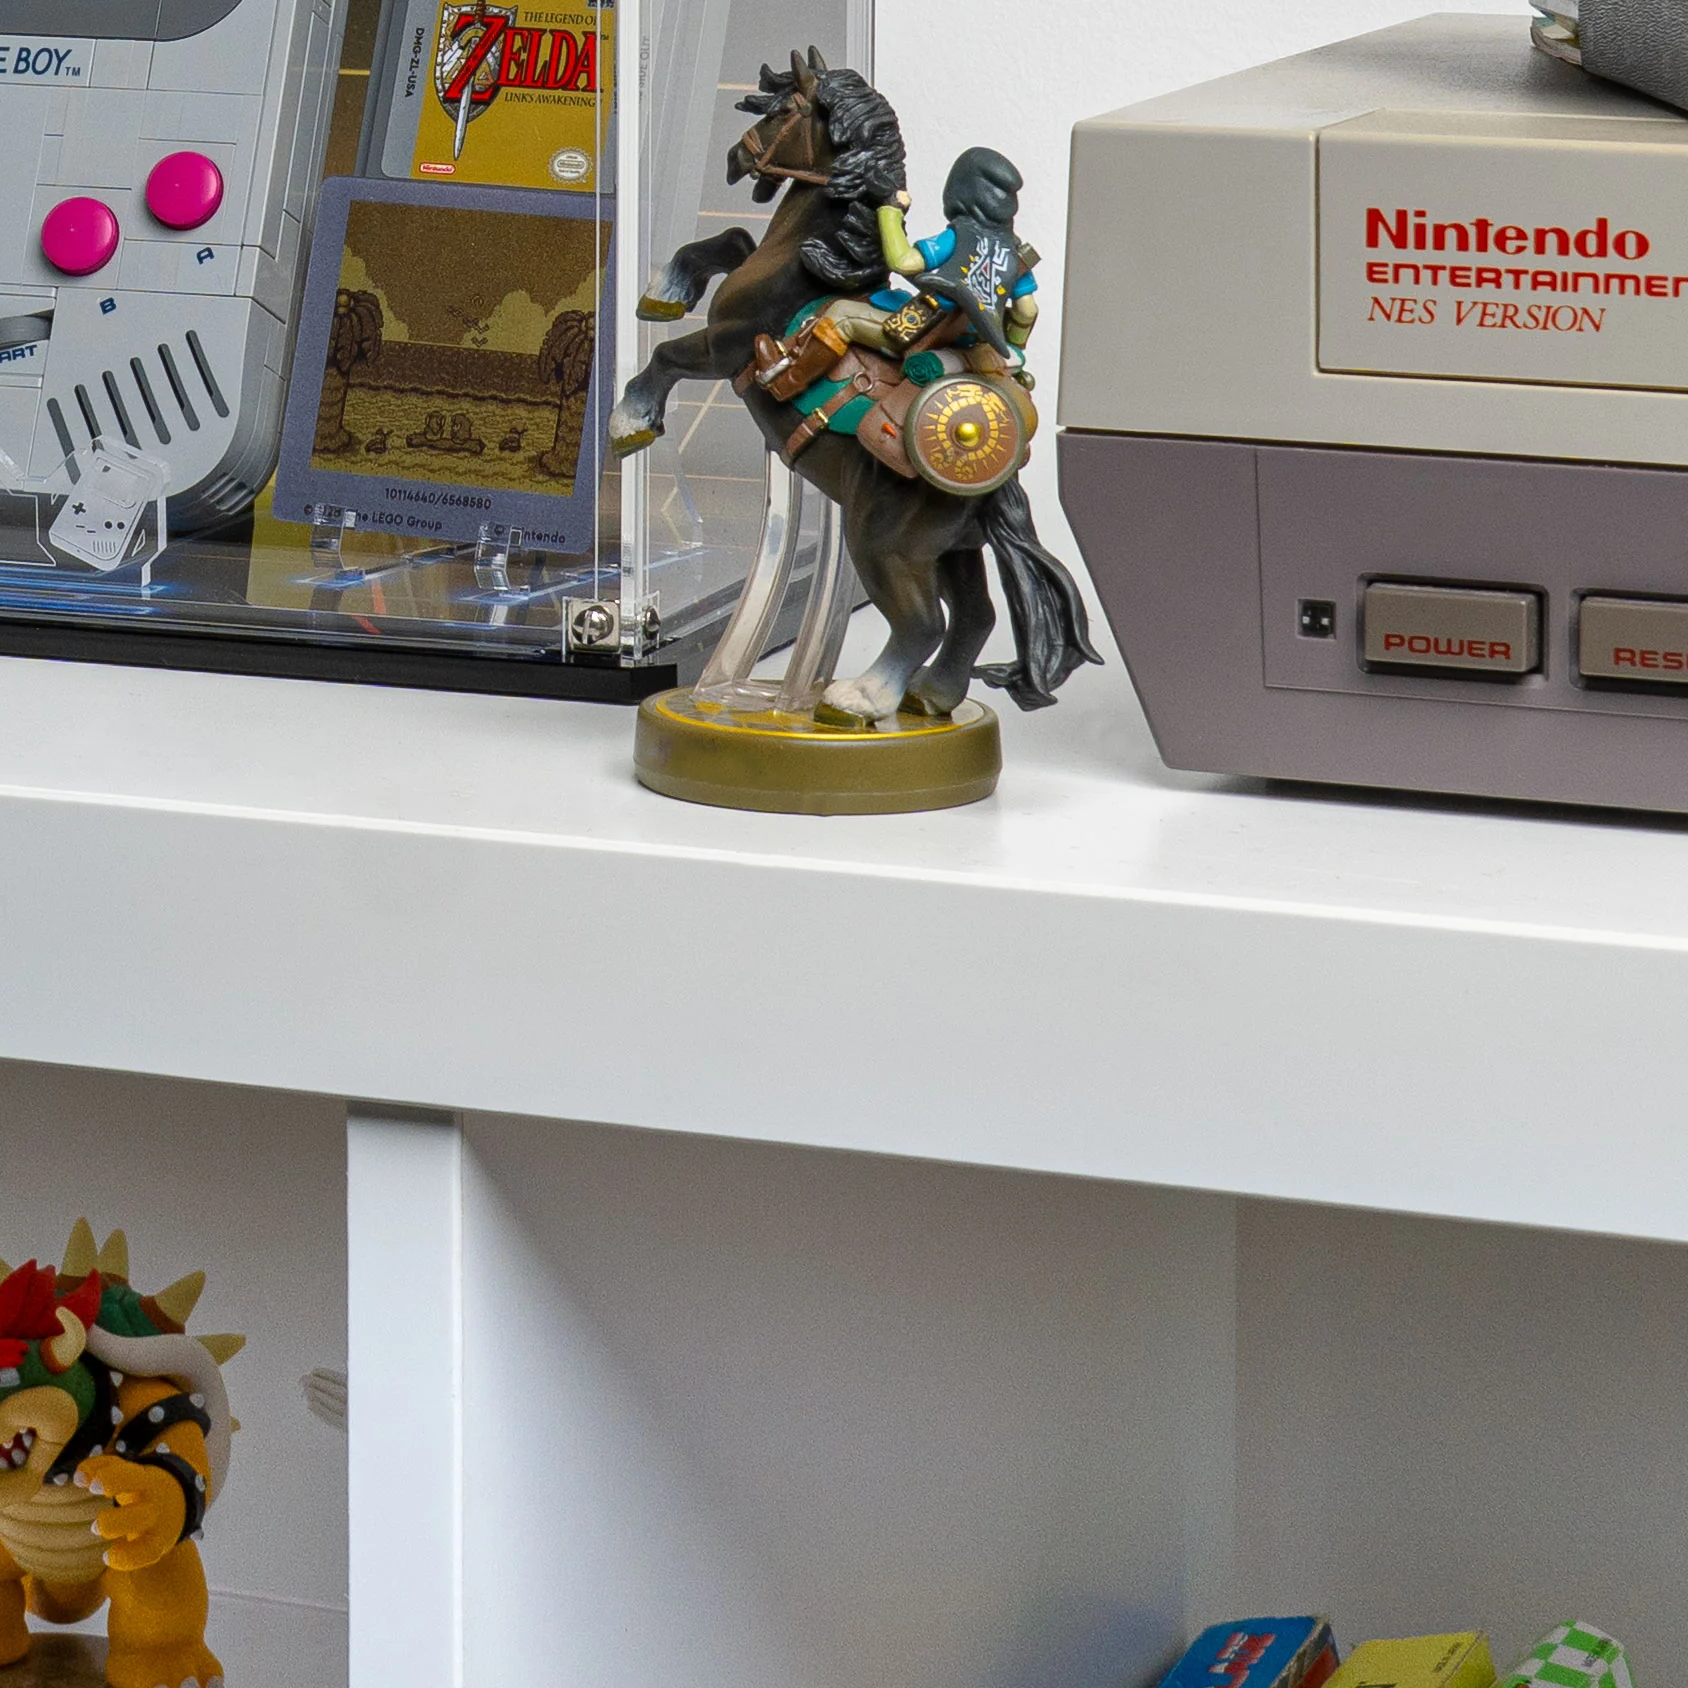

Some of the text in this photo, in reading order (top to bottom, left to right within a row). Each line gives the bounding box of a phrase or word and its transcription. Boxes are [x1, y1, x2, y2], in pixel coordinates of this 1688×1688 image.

[524, 11, 544, 23] THE
[544, 12, 584, 25] LEGEND
[405, 27, 425, 98] DMG-ZL-USA
[444, 13, 603, 104] ZELDA
[535, 93, 596, 108] AWAKENING
[1366, 207, 1650, 261] Nintendo
[196, 247, 215, 265] A
[99, 297, 117, 316] B
[1368, 296, 1606, 334] NES VERSION
[372, 511, 404, 527] LEGO
[407, 515, 443, 532] Group
[1384, 633, 1512, 660] POWER
